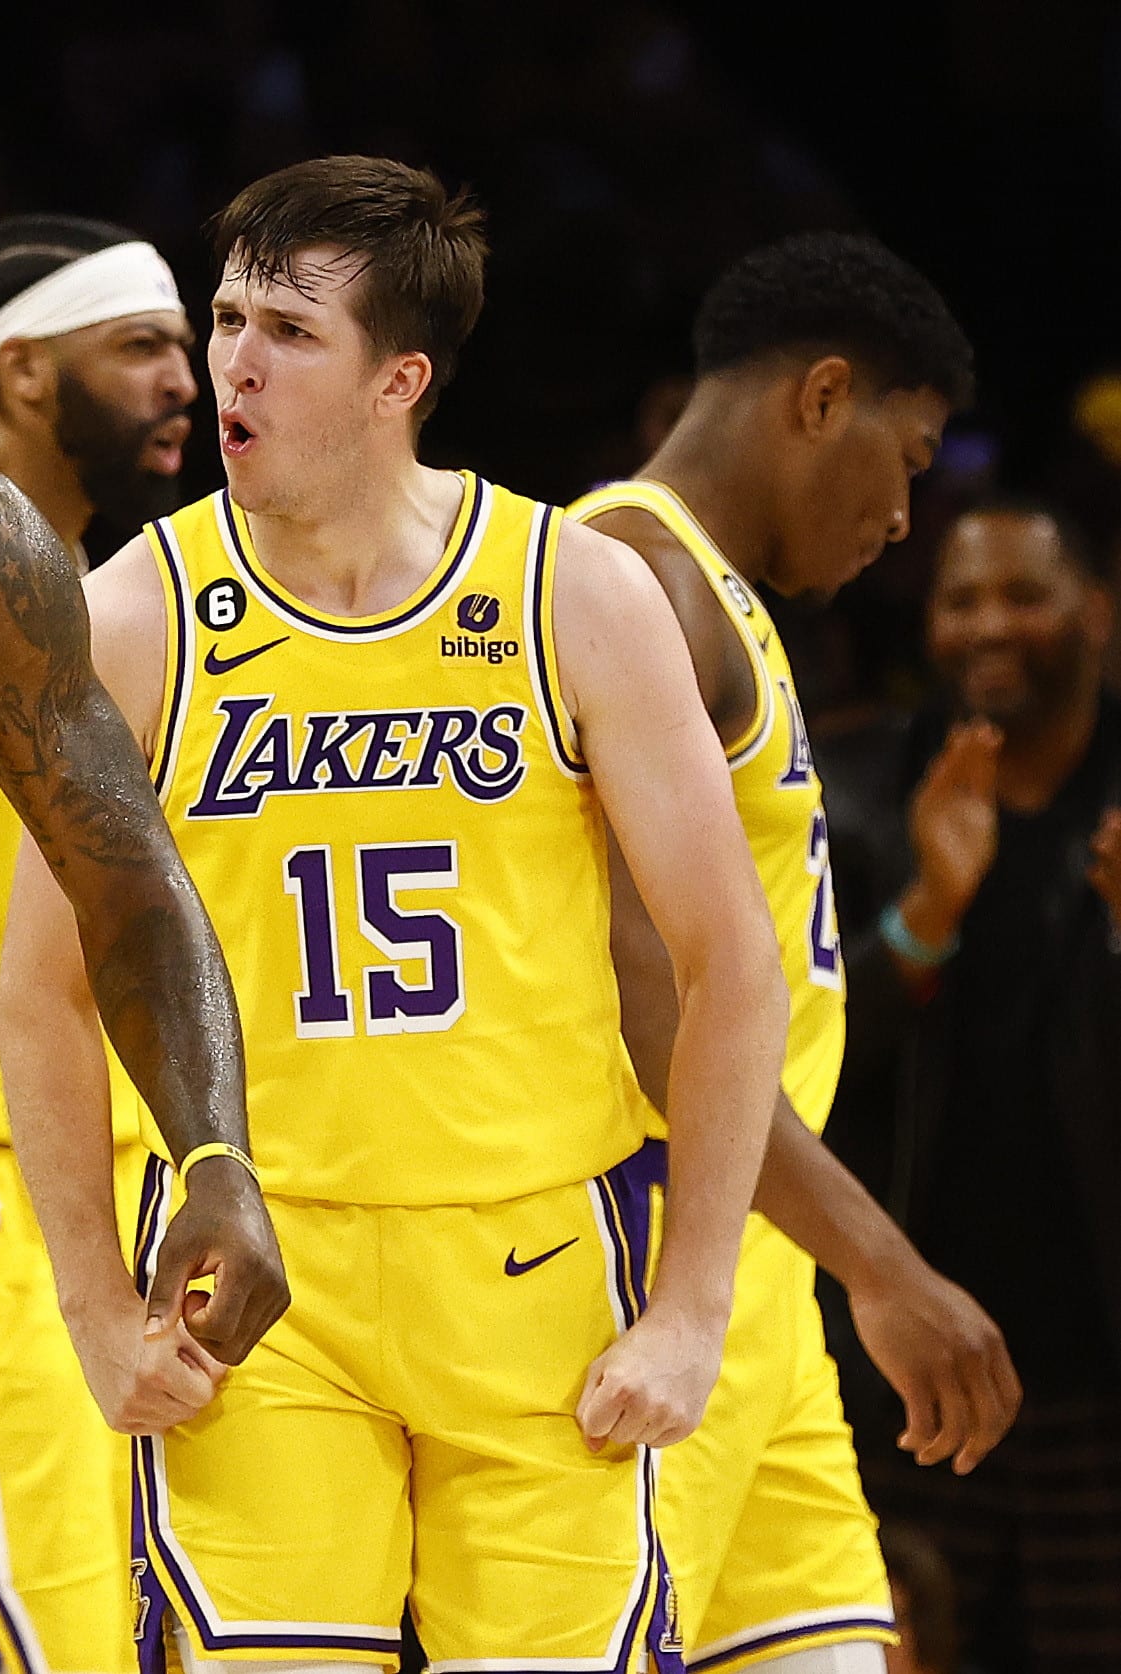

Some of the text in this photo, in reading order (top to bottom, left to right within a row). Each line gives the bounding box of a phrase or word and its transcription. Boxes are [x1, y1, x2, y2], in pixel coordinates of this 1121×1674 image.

[208, 584, 237, 627] 6
[441, 635, 519, 665] bibigo
[185, 693, 530, 821] LAKERS
[282, 839, 466, 1039] 15
[805, 808, 843, 992] 2
